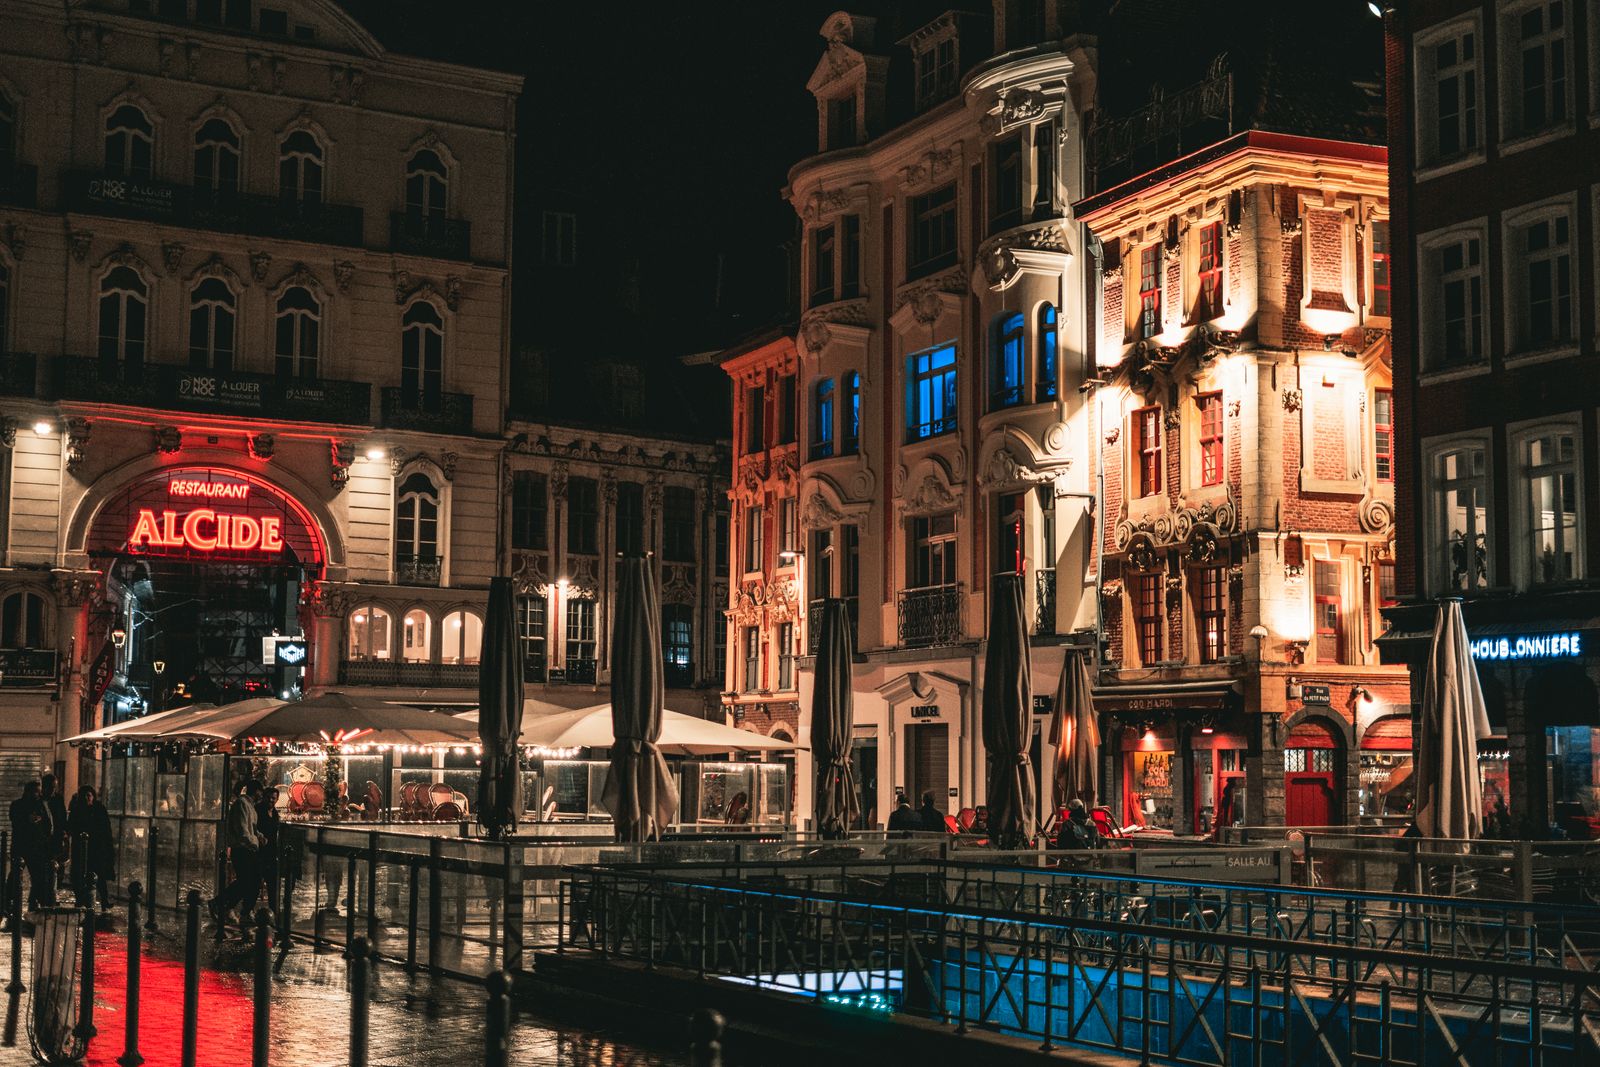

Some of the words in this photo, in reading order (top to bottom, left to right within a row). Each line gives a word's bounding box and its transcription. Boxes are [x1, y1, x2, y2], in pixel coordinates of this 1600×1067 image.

[193, 377, 216, 388] NOC
[230, 382, 260, 393] LOUER
[192, 387, 216, 397] NOC
[169, 481, 249, 499] RESTAURANT
[129, 508, 284, 551] ALCIDE
[1470, 634, 1581, 659] HOUBLONNIERE
[911, 705, 940, 718] LANCEL
[1228, 857, 1253, 867] SALLE
[1256, 857, 1271, 867] AU
